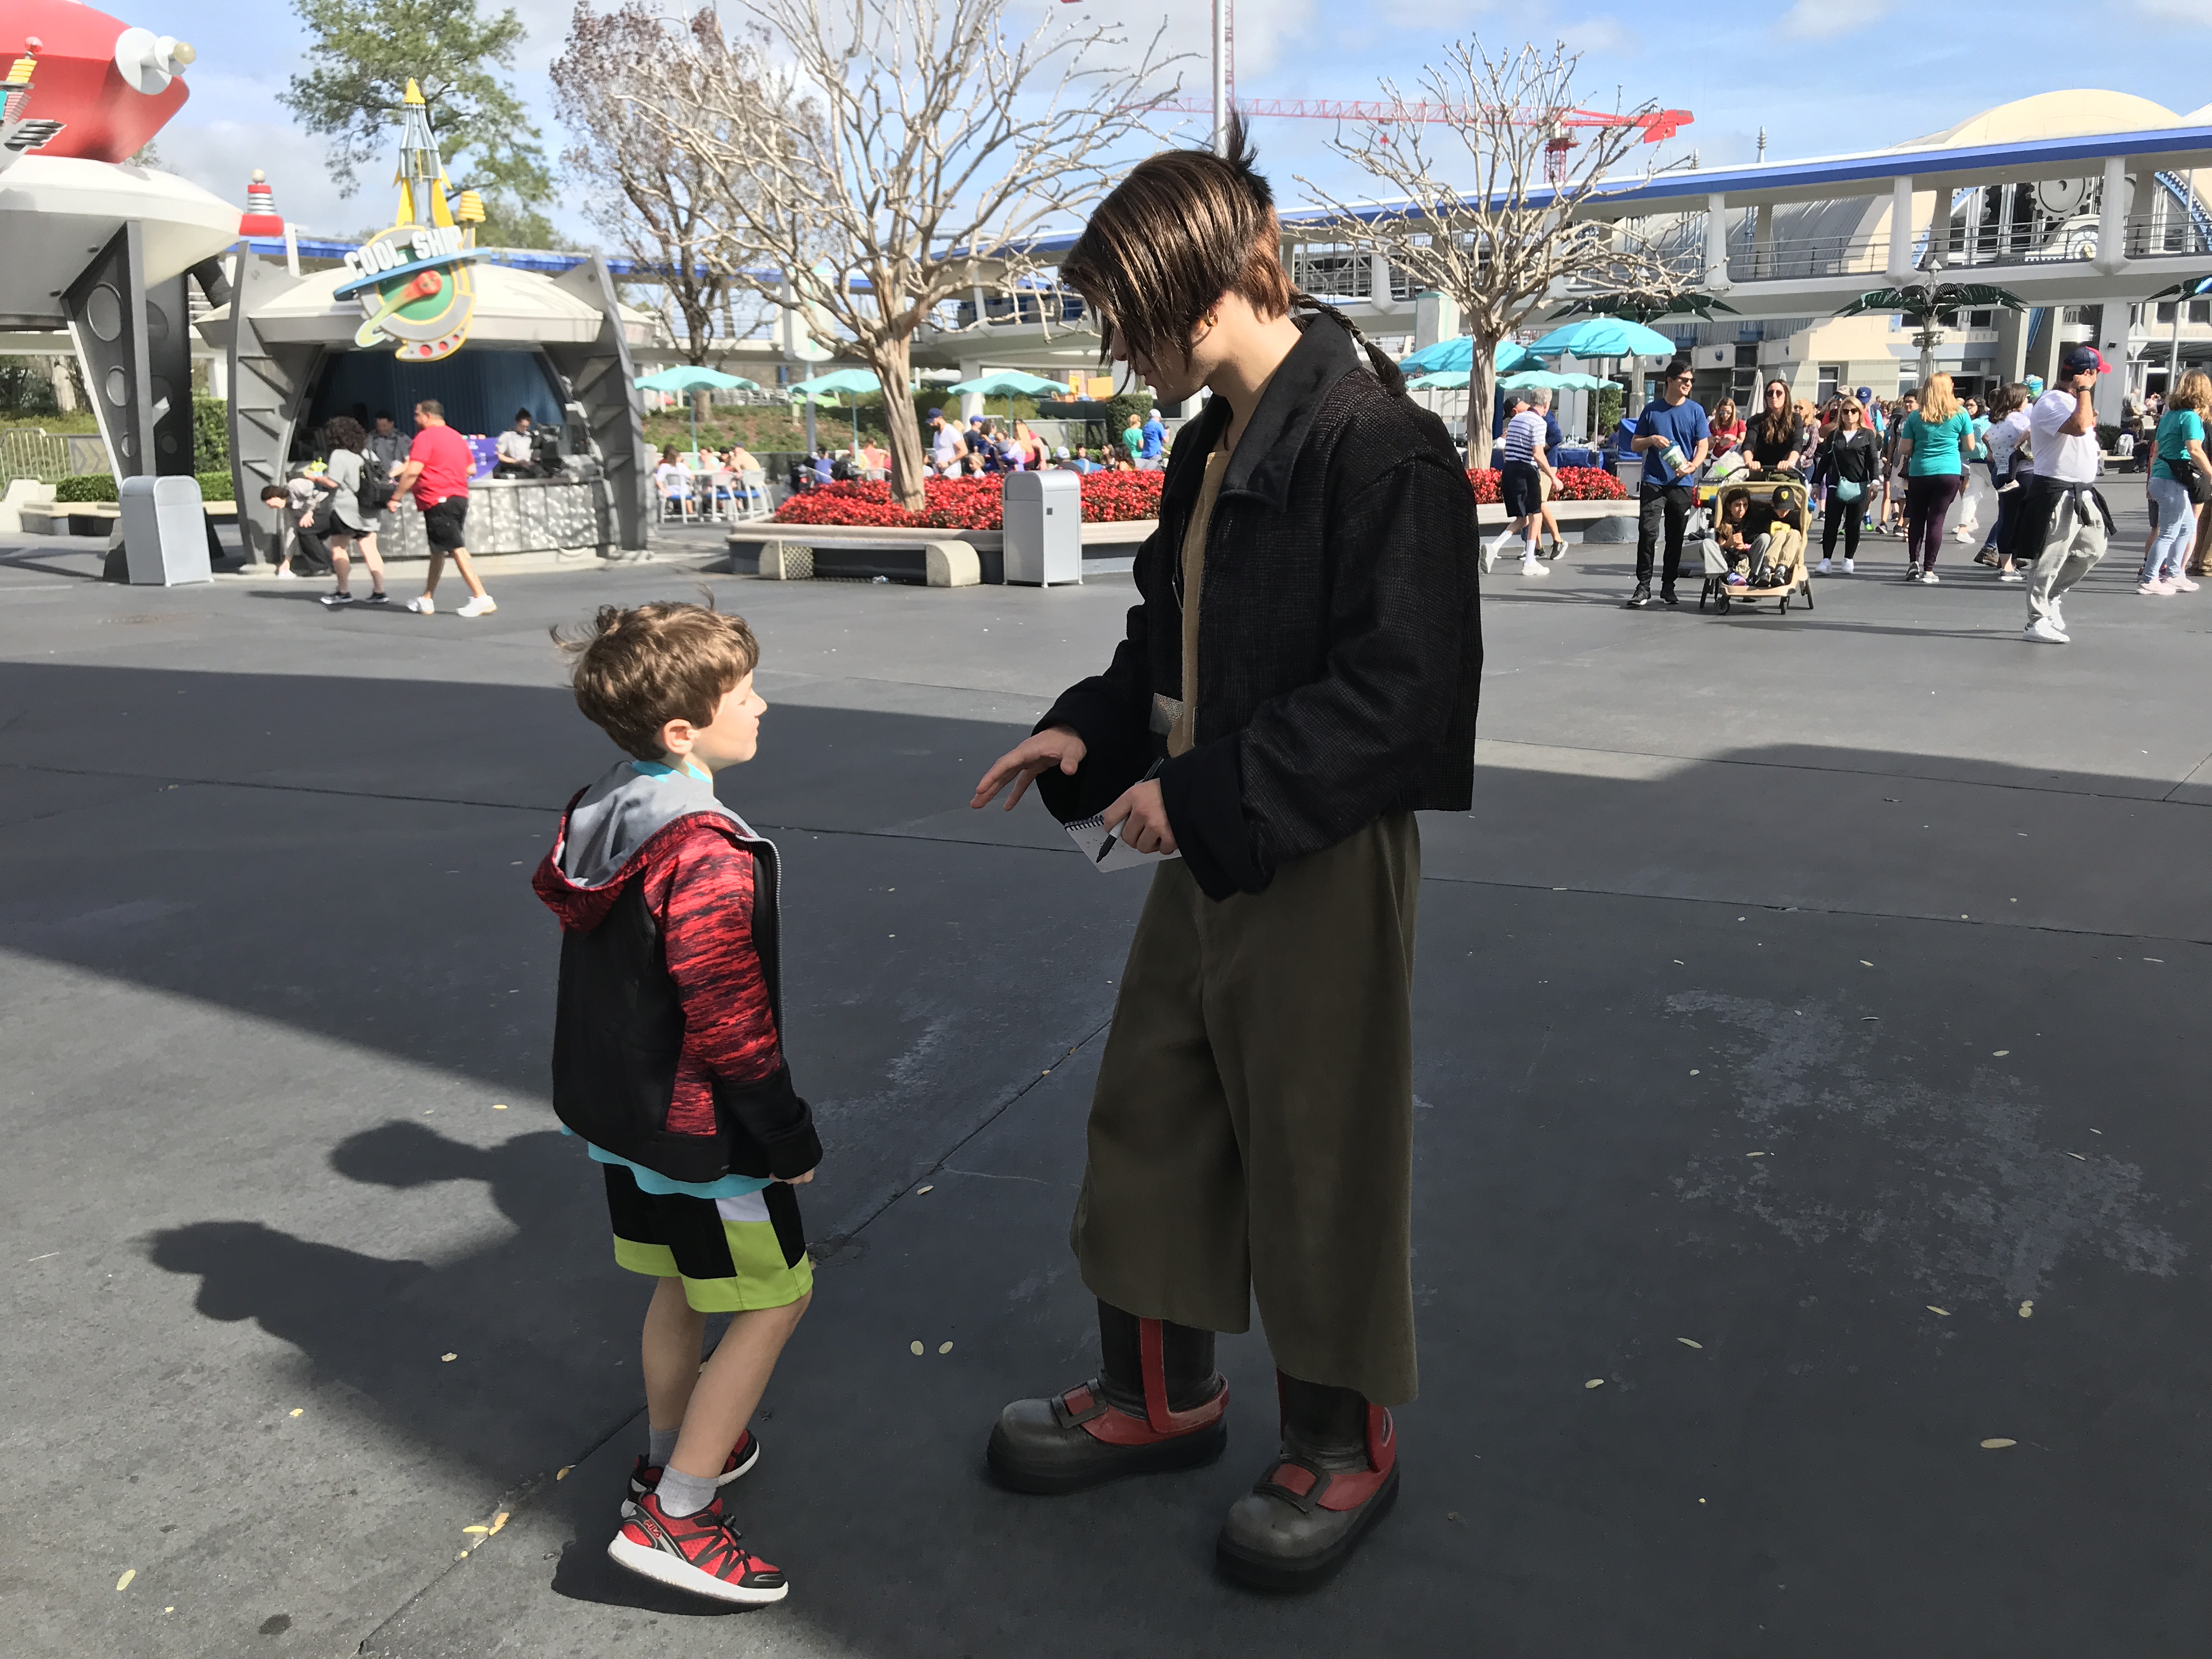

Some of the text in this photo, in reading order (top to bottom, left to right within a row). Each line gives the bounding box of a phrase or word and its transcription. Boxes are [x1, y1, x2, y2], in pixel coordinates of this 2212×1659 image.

[344, 225, 462, 280] COOL SHIP
[644, 1519, 662, 1539] FILA
